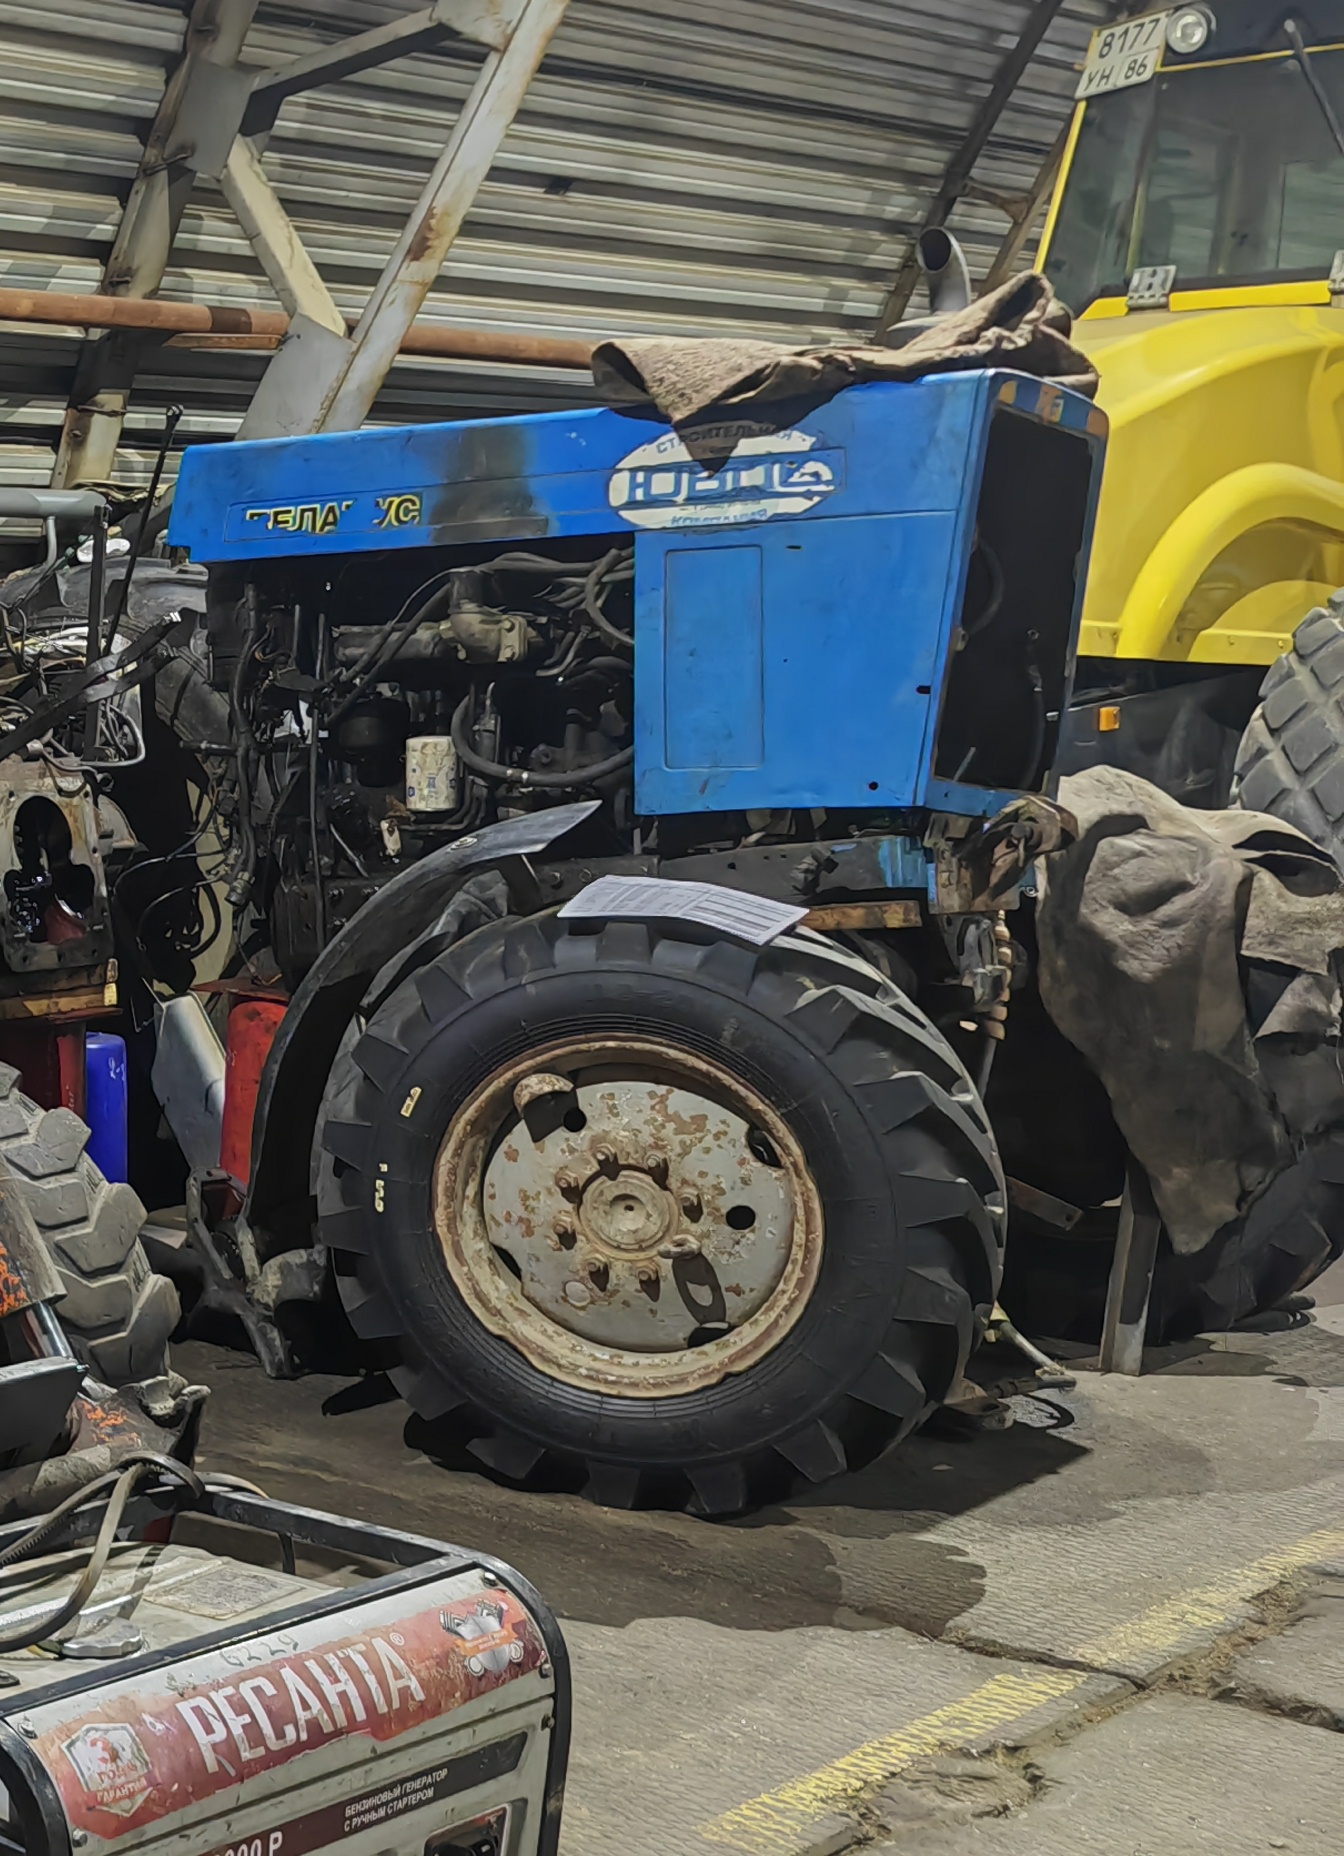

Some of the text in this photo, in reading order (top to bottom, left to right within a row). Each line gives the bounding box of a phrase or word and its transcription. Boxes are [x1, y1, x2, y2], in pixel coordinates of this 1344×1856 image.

[1099, 18, 1160, 59] 8177
[1123, 55, 1149, 81] 86
[175, 1637, 427, 1778] РЕСАНТА
[344, 1787, 435, 1832] С РУЧНЫМ СТАРТЕРОМ
[345, 1768, 448, 1818] БЕНЗИНОВЫЙ ГЕНЕРАТОР
